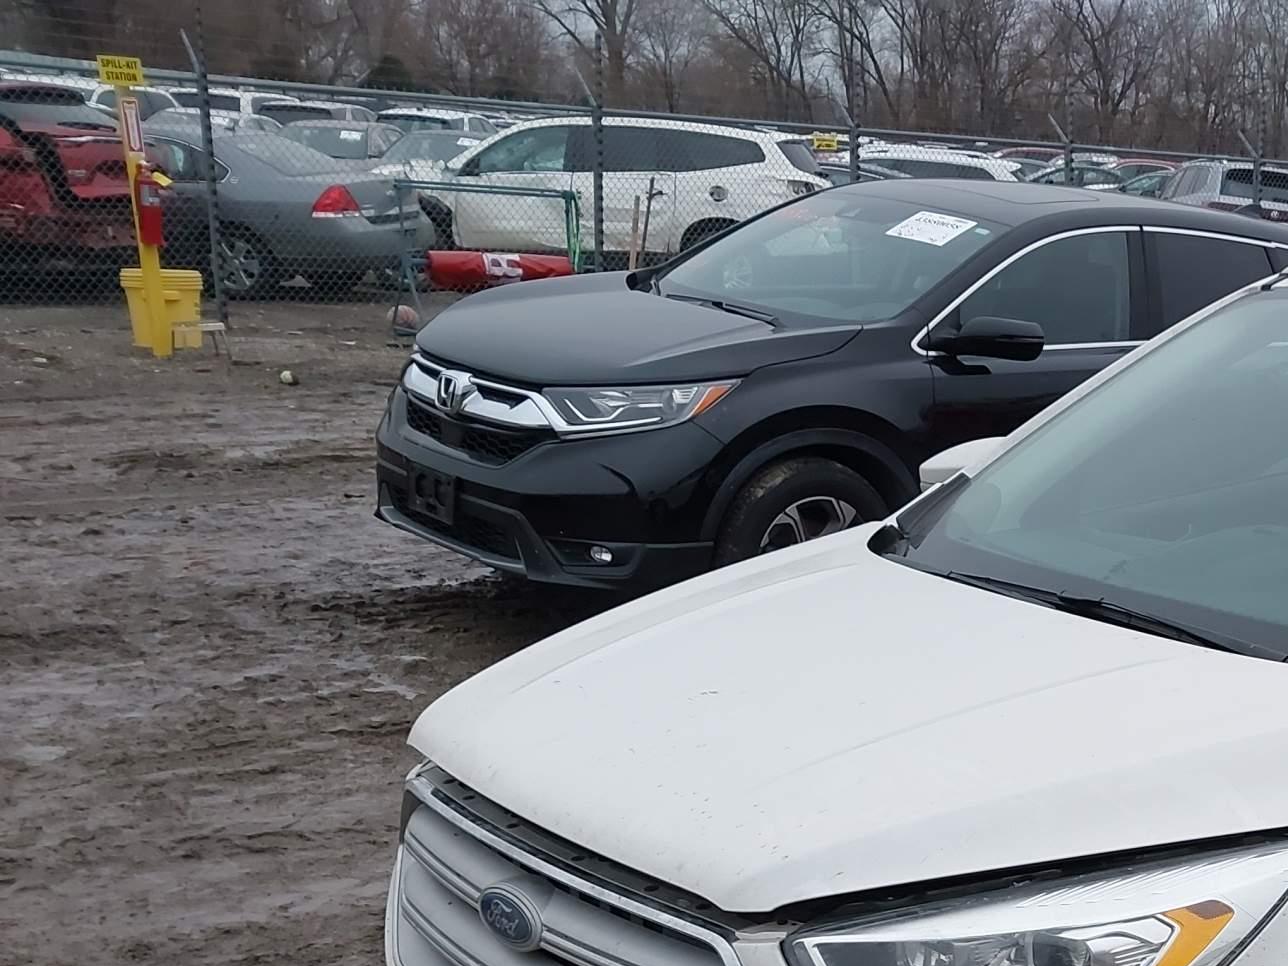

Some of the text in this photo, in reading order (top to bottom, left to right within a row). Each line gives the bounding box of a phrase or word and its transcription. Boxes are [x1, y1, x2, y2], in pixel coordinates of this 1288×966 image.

[101, 58, 137, 70] SPILL-KIT
[105, 71, 137, 81] STATION
[486, 898, 520, 937] Ford
